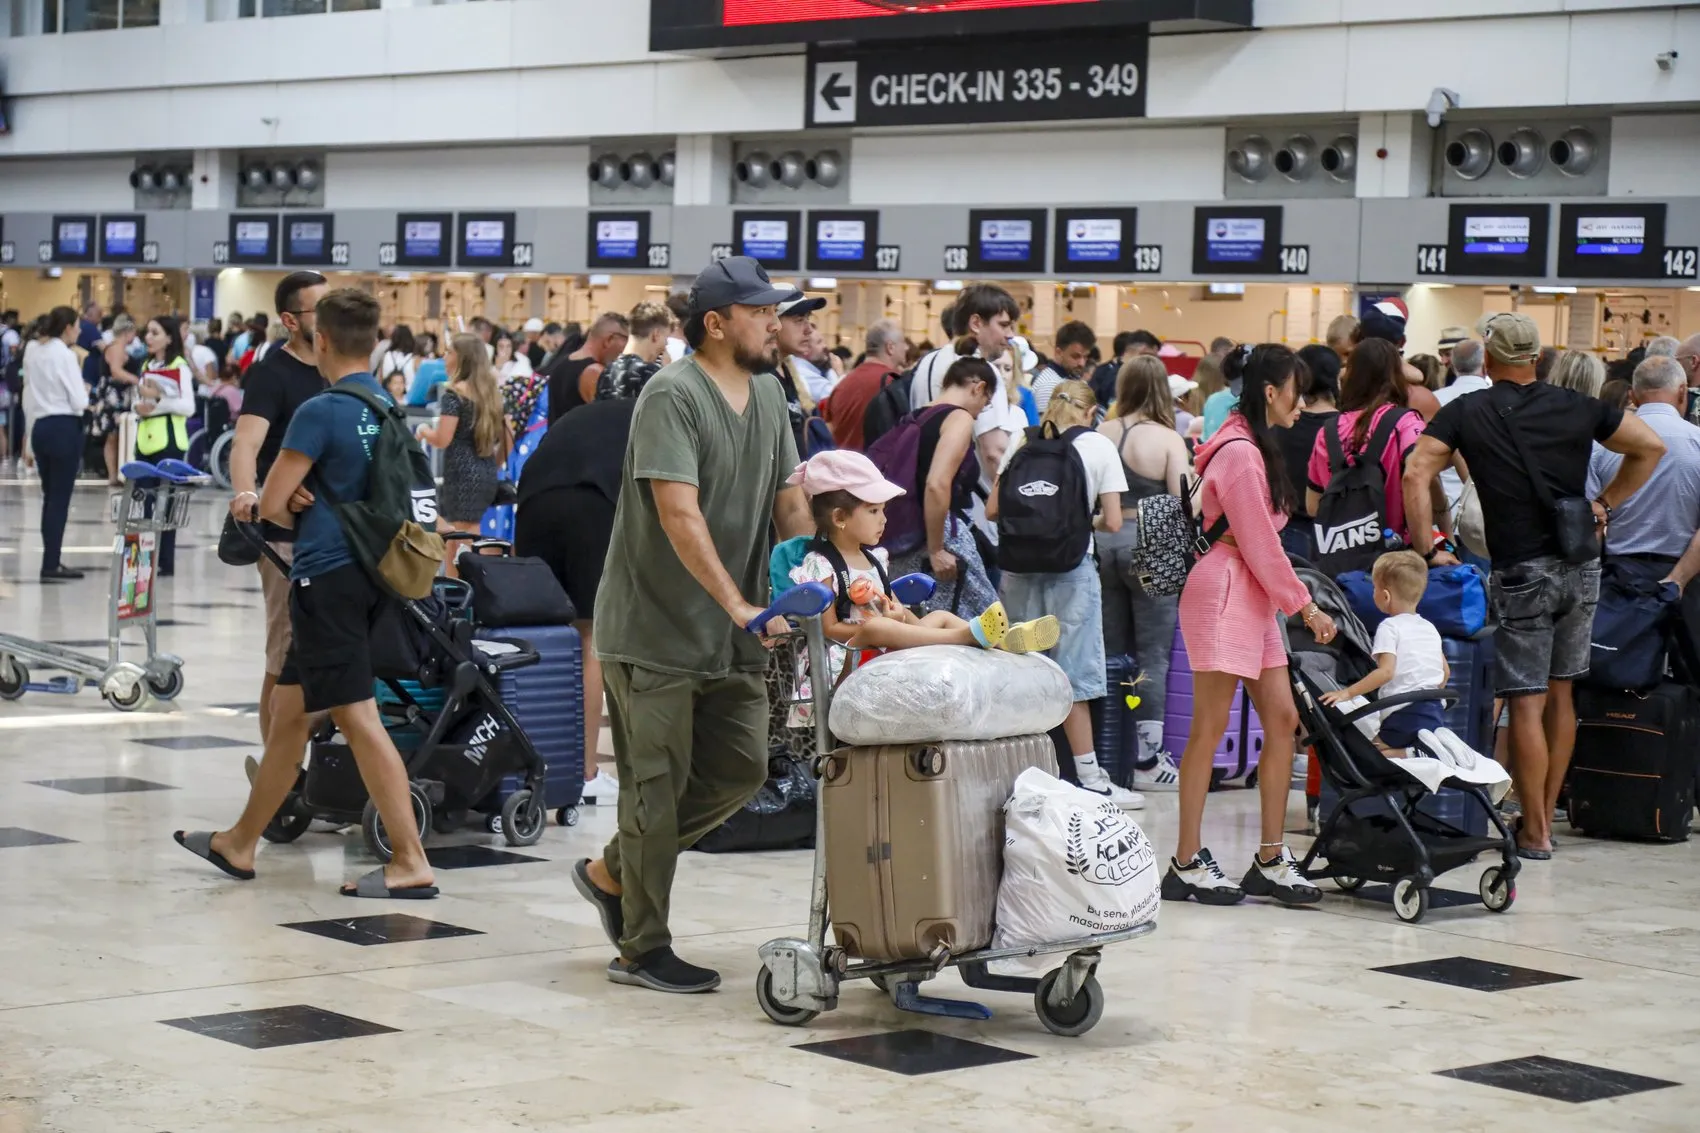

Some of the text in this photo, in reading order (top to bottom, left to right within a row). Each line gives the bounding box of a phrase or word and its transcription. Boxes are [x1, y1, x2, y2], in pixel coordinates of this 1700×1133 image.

[869, 70, 1005, 106] CHECK-IN
[1012, 67, 1062, 101] 335
[1087, 63, 1139, 97] 349
[214, 244, 229, 262] 131
[331, 244, 348, 263] 132
[379, 244, 397, 264] 133
[513, 244, 532, 265] 134
[648, 245, 669, 267] 135
[876, 247, 899, 269] 137
[944, 247, 968, 270] 138
[1135, 247, 1161, 271] 139
[1280, 247, 1308, 272] 140
[1419, 247, 1447, 273] 141
[1664, 249, 1697, 276] 142
[1313, 511, 1382, 554] VANS
